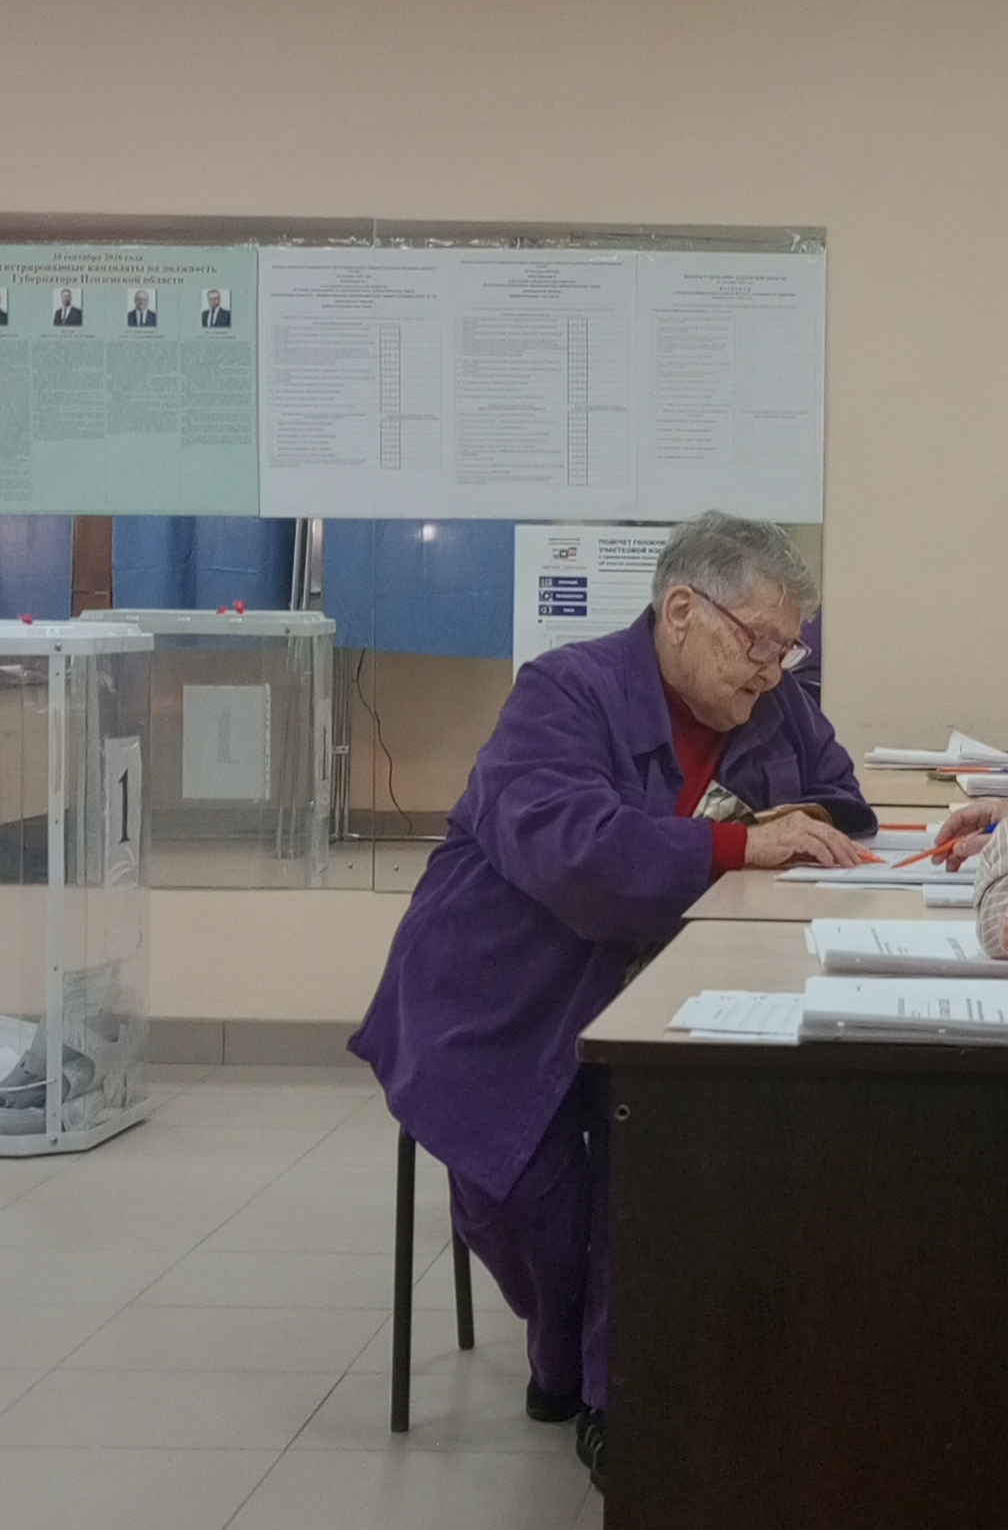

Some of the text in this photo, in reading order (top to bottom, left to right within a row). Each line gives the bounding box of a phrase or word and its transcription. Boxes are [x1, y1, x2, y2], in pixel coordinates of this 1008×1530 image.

[87, 264, 144, 274] кандидаты
[147, 265, 159, 273] на
[162, 265, 218, 274] должность
[12, 274, 184, 285] Губернатора Пензенской области
[117, 767, 131, 845] 1
